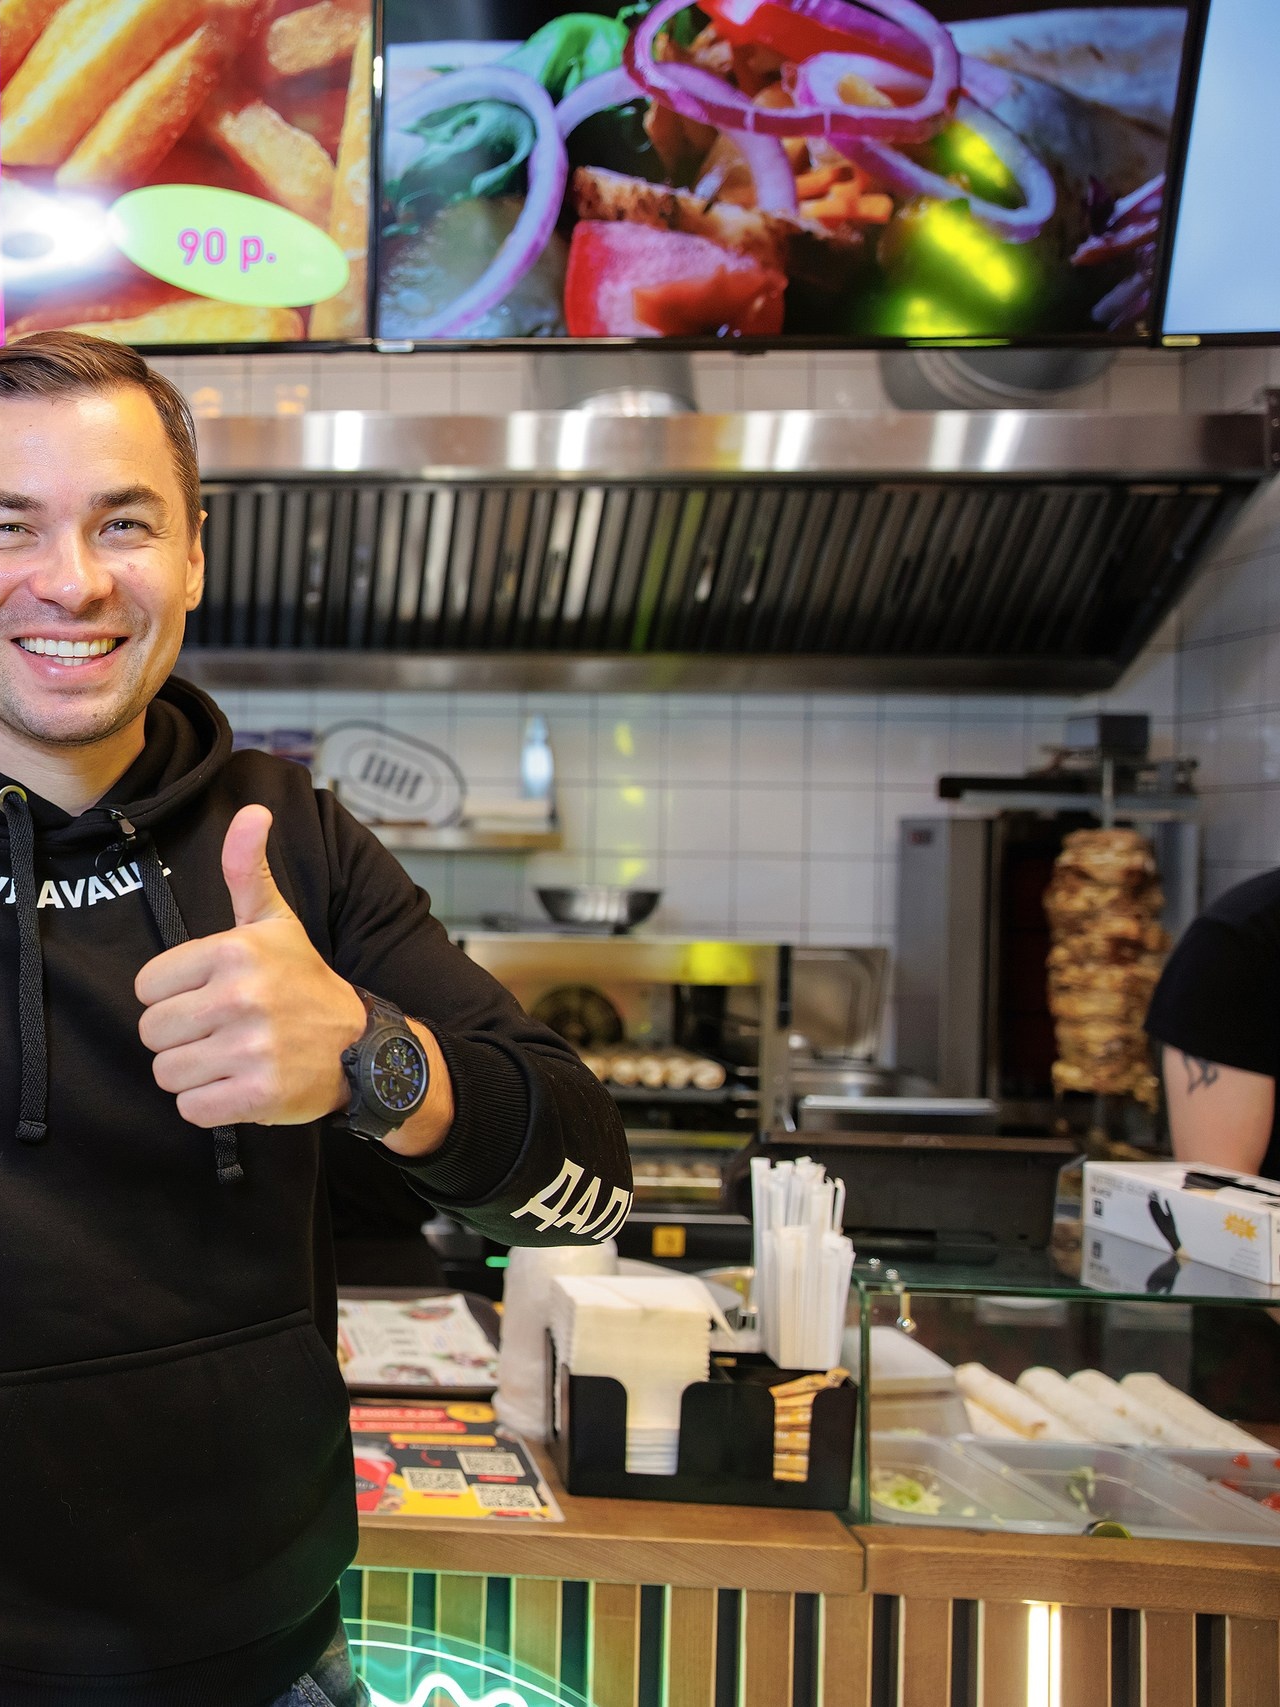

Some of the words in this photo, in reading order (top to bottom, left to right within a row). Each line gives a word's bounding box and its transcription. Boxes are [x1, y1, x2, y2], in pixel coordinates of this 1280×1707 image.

[178, 227, 228, 266] 90
[239, 231, 278, 272] р.
[510, 1157, 634, 1243] ДАЛ
